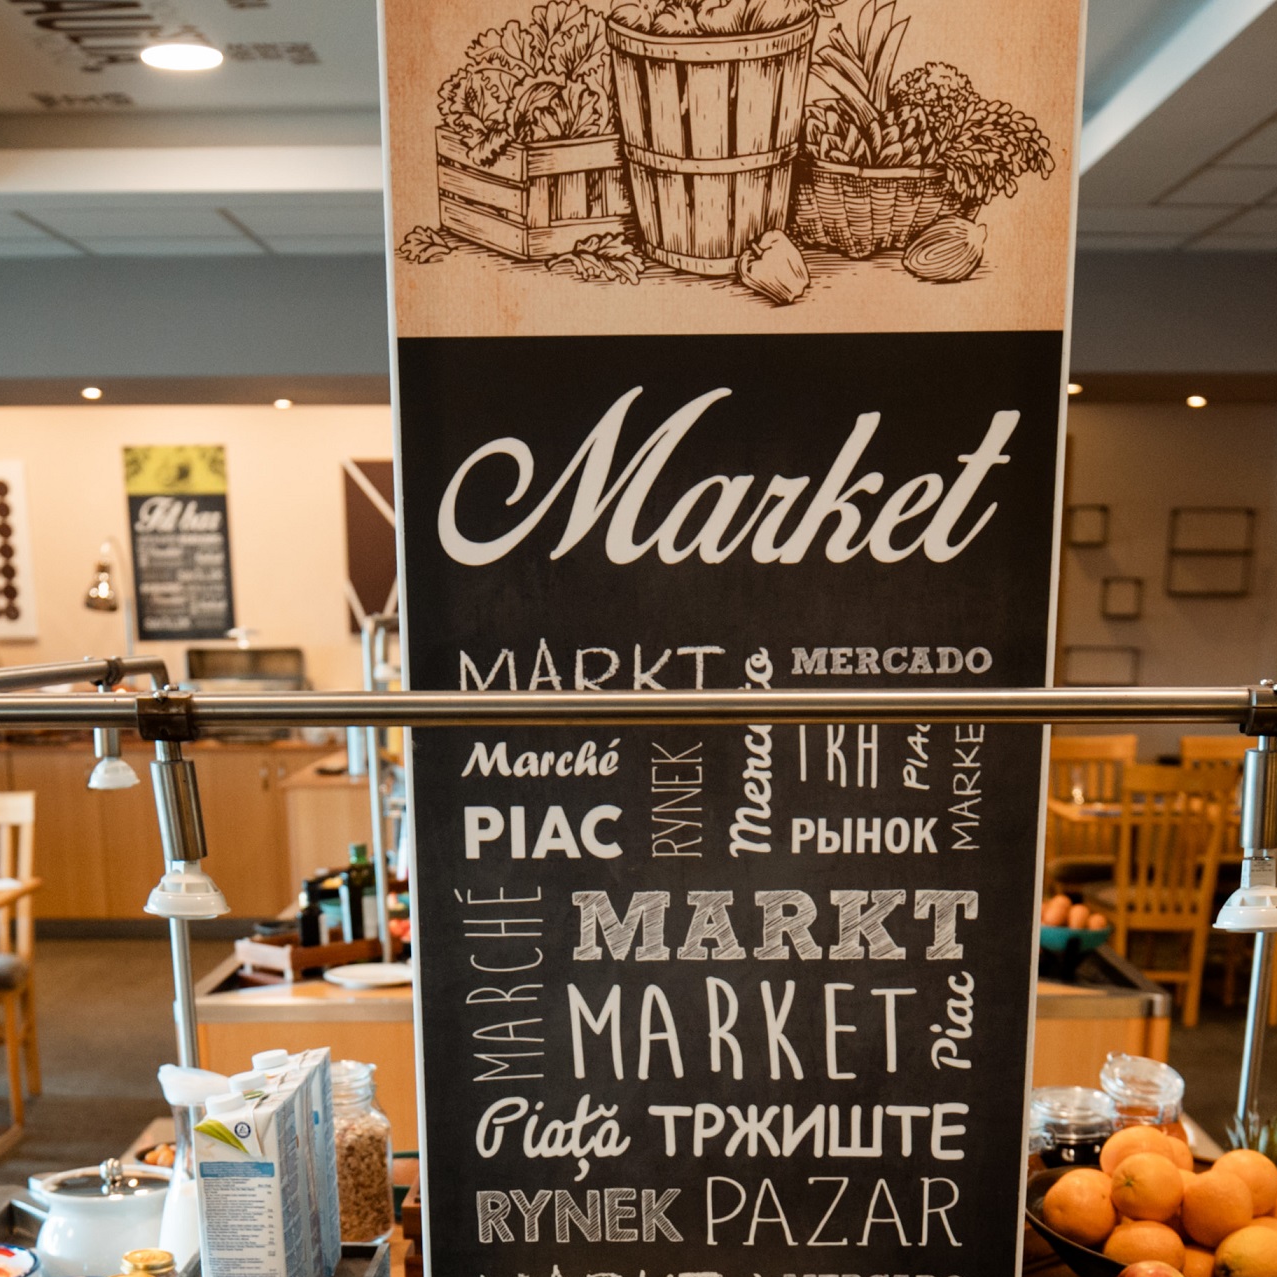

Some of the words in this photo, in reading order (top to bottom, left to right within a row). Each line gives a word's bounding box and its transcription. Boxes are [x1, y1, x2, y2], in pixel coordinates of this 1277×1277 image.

[437, 385, 1021, 567] Market
[459, 637, 726, 691] MARKT
[790, 646, 993, 675] MERCADO
[460, 737, 621, 778] Marché
[463, 804, 624, 860] PIAC
[650, 741, 703, 858] RYNEK
[790, 816, 939, 855] РЫНОК
[571, 888, 979, 962] MARKT
[453, 885, 545, 1082] MARCHÉ
[566, 975, 918, 1081] MARKET
[929, 970, 975, 1070] Piac
[647, 1102, 970, 1161] ТРЖИШТЕ
[475, 1187, 684, 1244] RYNEK
[706, 1175, 963, 1247] PAZAR
